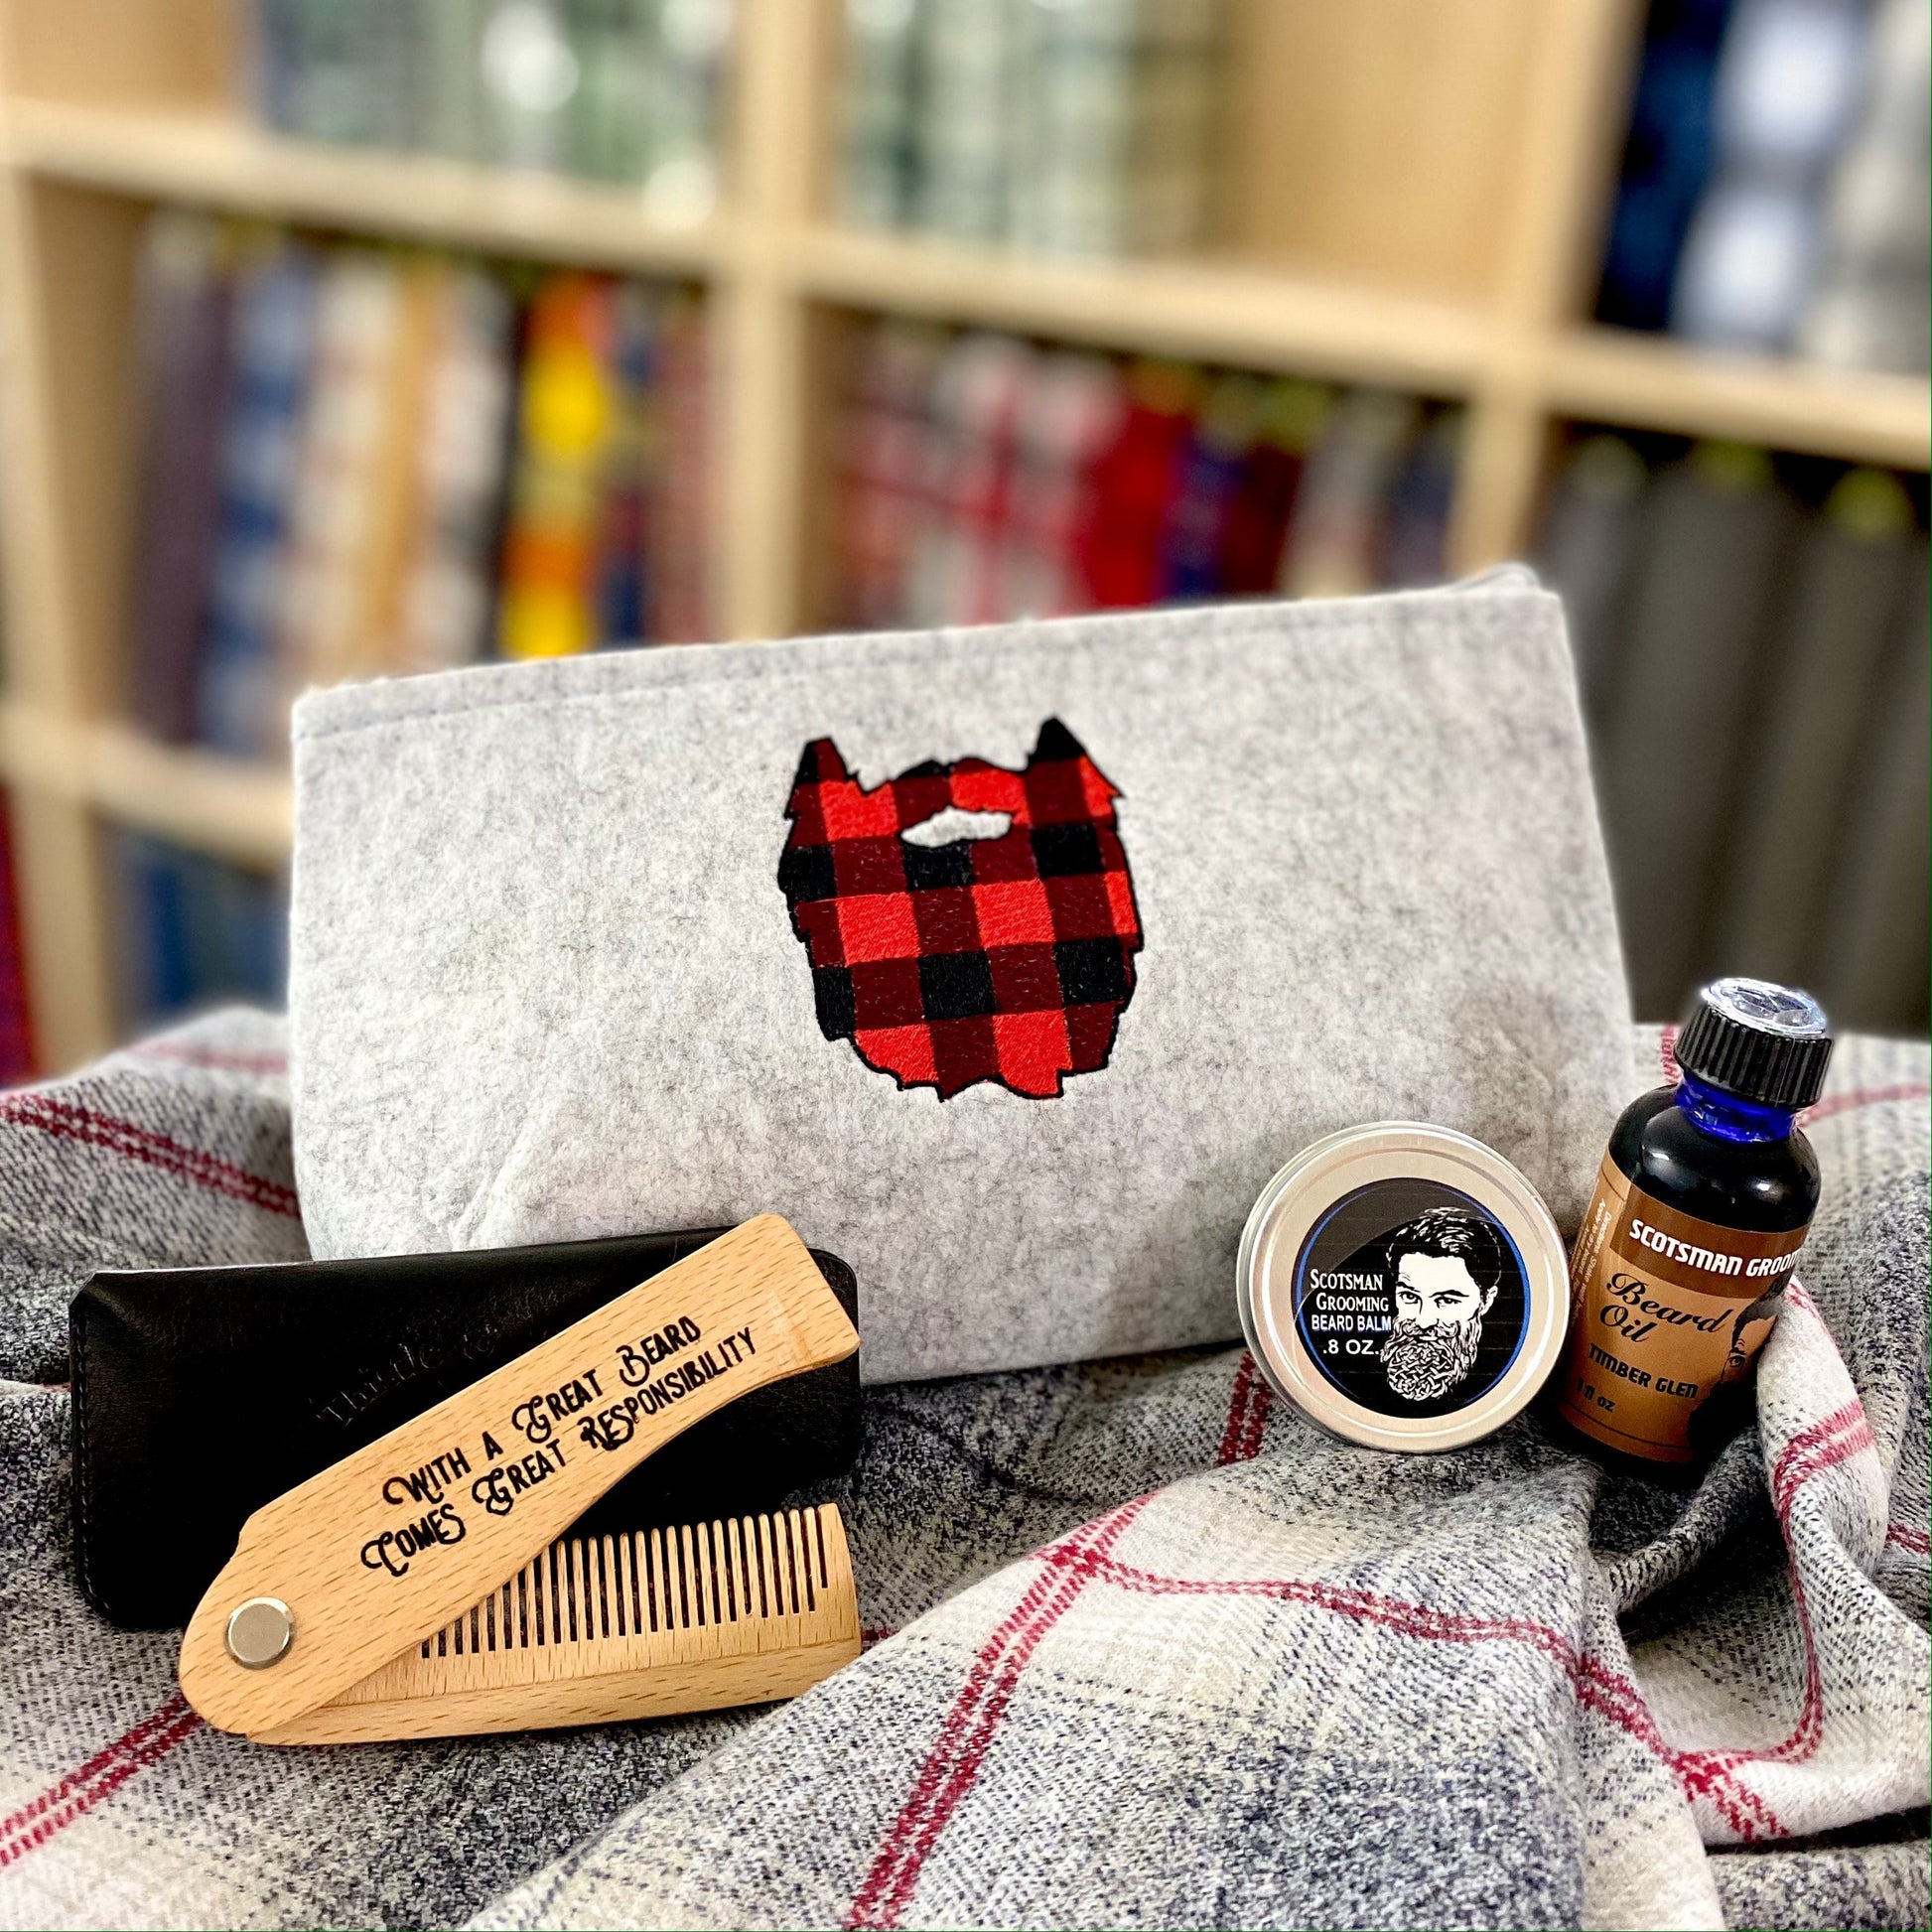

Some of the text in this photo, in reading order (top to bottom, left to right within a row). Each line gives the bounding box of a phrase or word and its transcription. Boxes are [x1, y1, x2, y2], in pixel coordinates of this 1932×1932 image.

[1628, 1219, 1743, 1277] SCOTSMAN
[1310, 1268, 1384, 1292] SCOTSMAN
[1314, 1292, 1390, 1312] GROOMING
[1605, 1272, 1735, 1333] Beard
[1311, 1313, 1392, 1332] BEARD BALM
[1598, 1304, 1658, 1344] Oil
[1321, 1339, 1380, 1355] .8 OZ.
[1587, 1342, 1700, 1399] TIMBER GLEN
[382, 1314, 703, 1506] WITH A GREAT BEARD
[1596, 1395, 1616, 1414] oz
[359, 1326, 758, 1578] COMES GREAT RESPONSIBILITY
